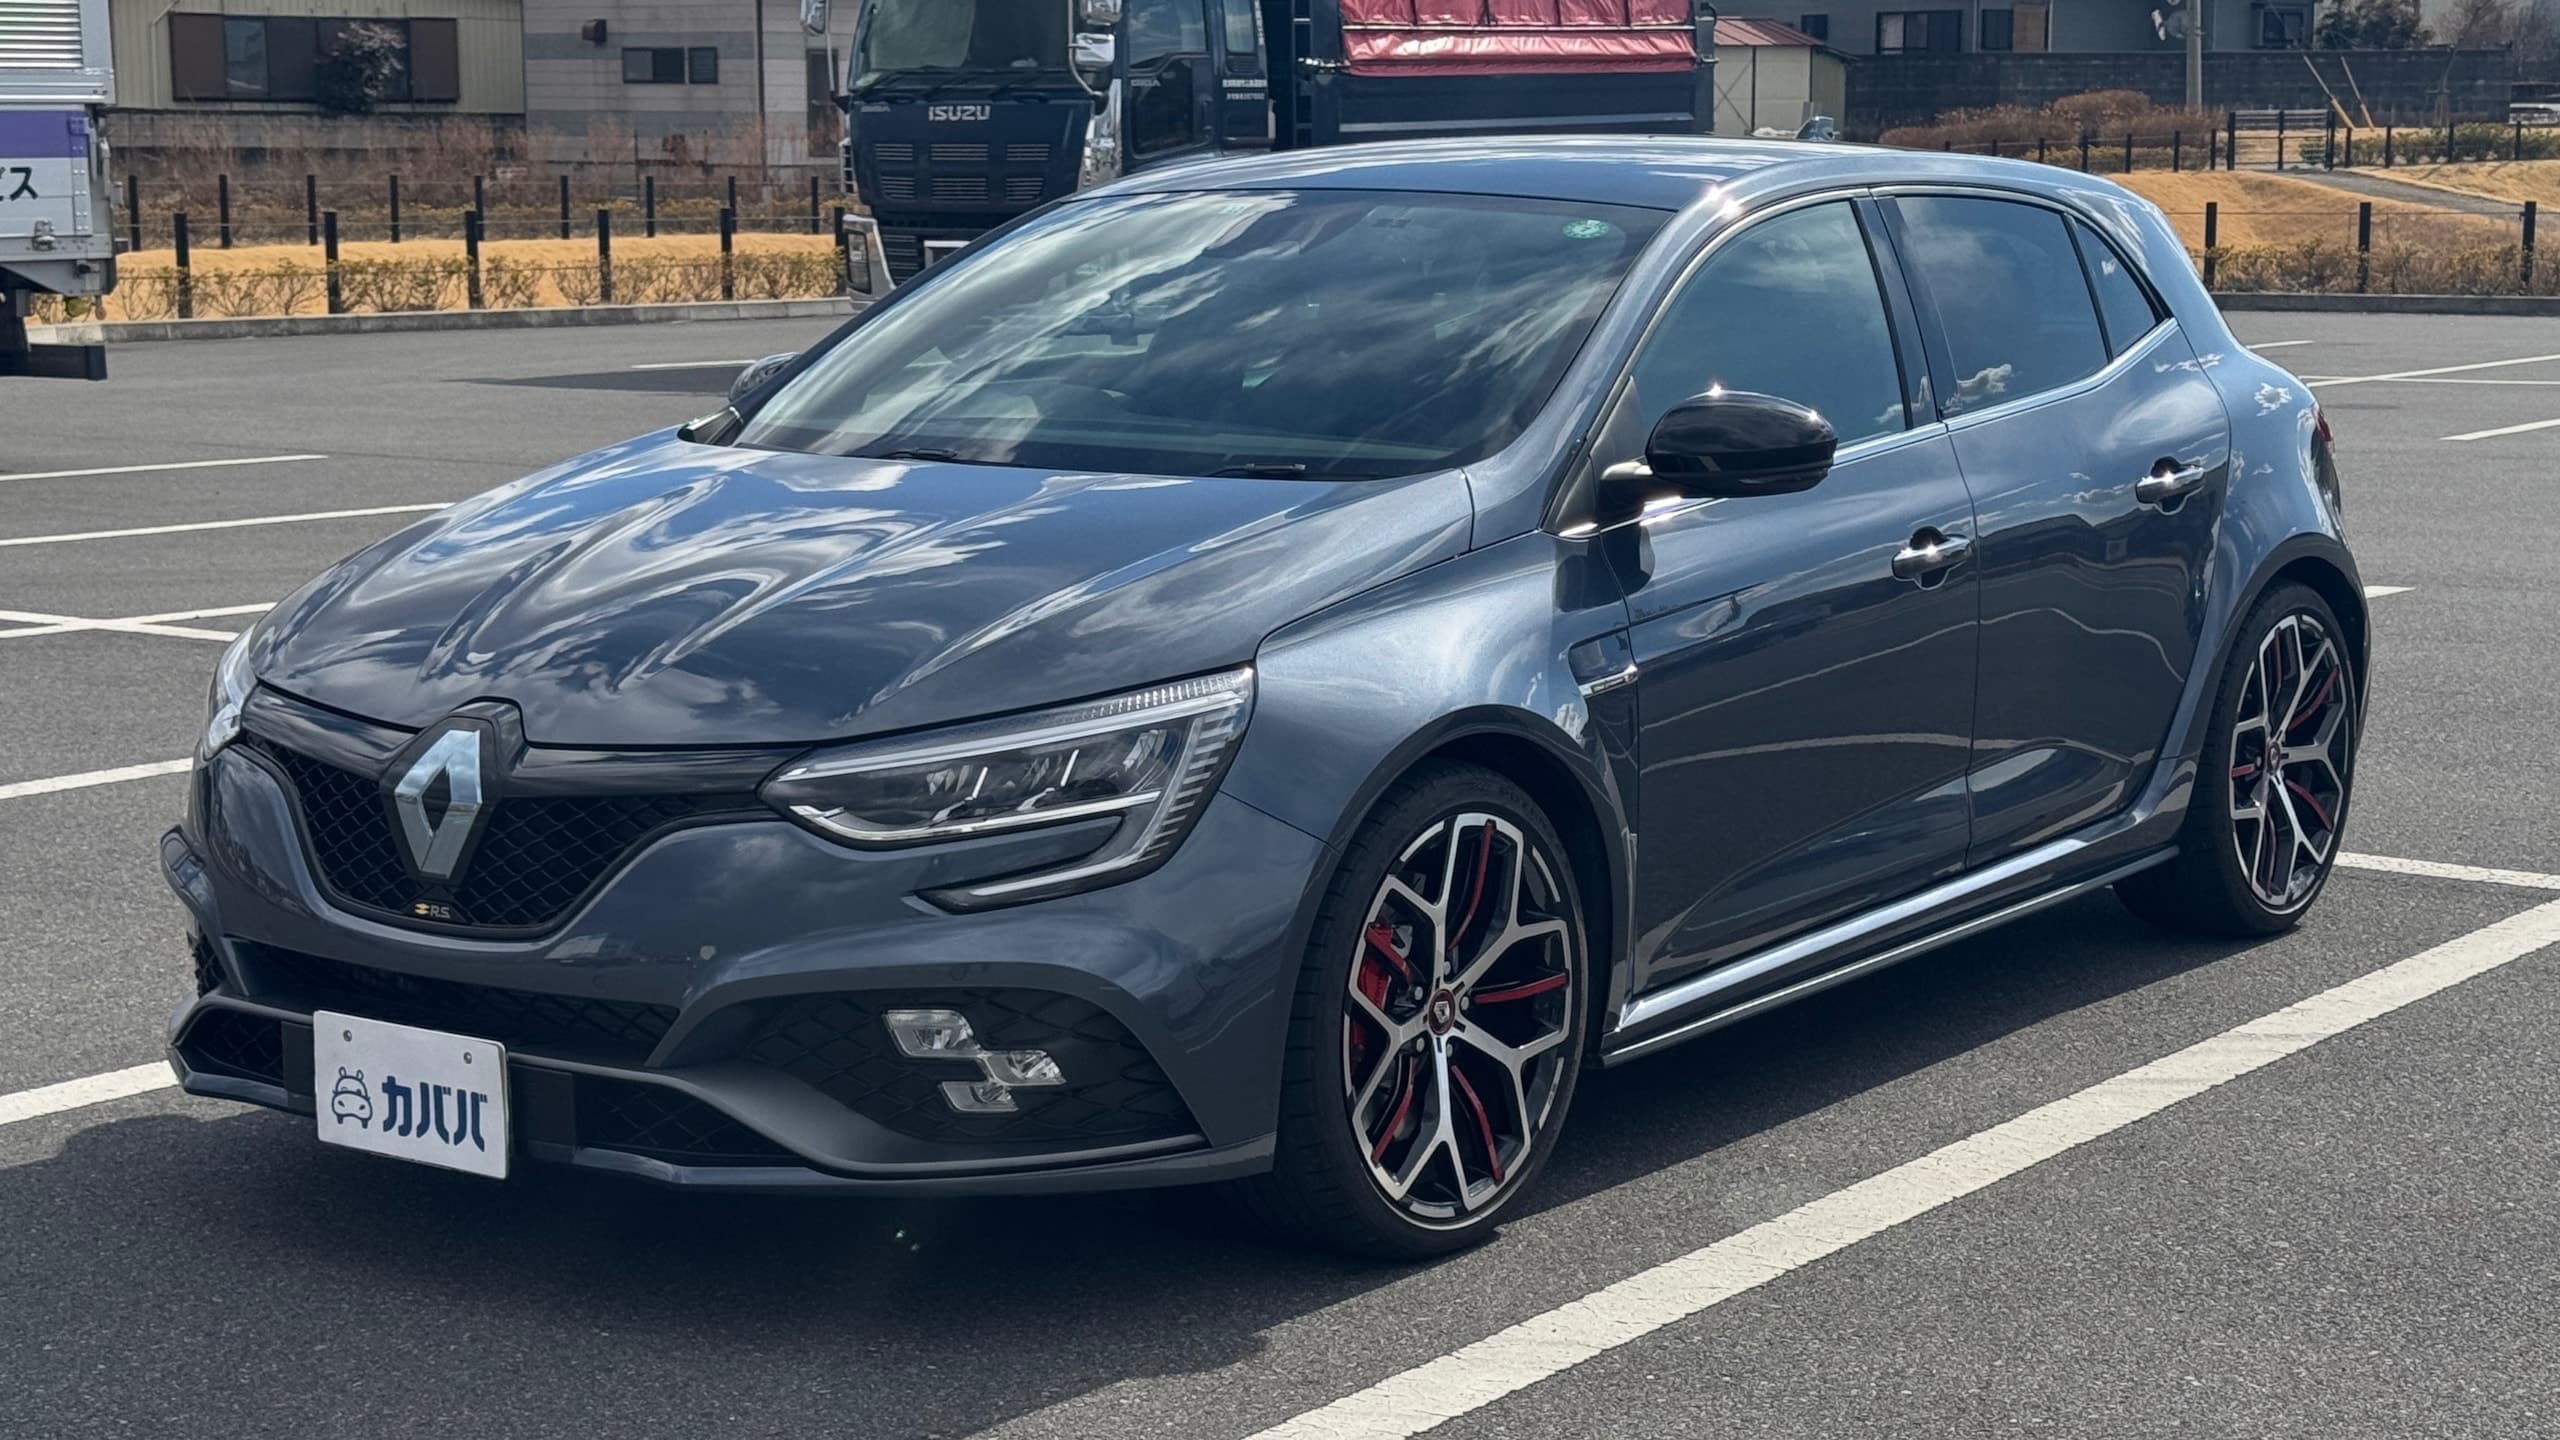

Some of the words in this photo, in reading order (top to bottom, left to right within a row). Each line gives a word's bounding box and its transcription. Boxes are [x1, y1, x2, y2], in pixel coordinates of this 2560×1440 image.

[928, 105, 991, 121] ISUZU
[382, 1076, 488, 1152] カババ
